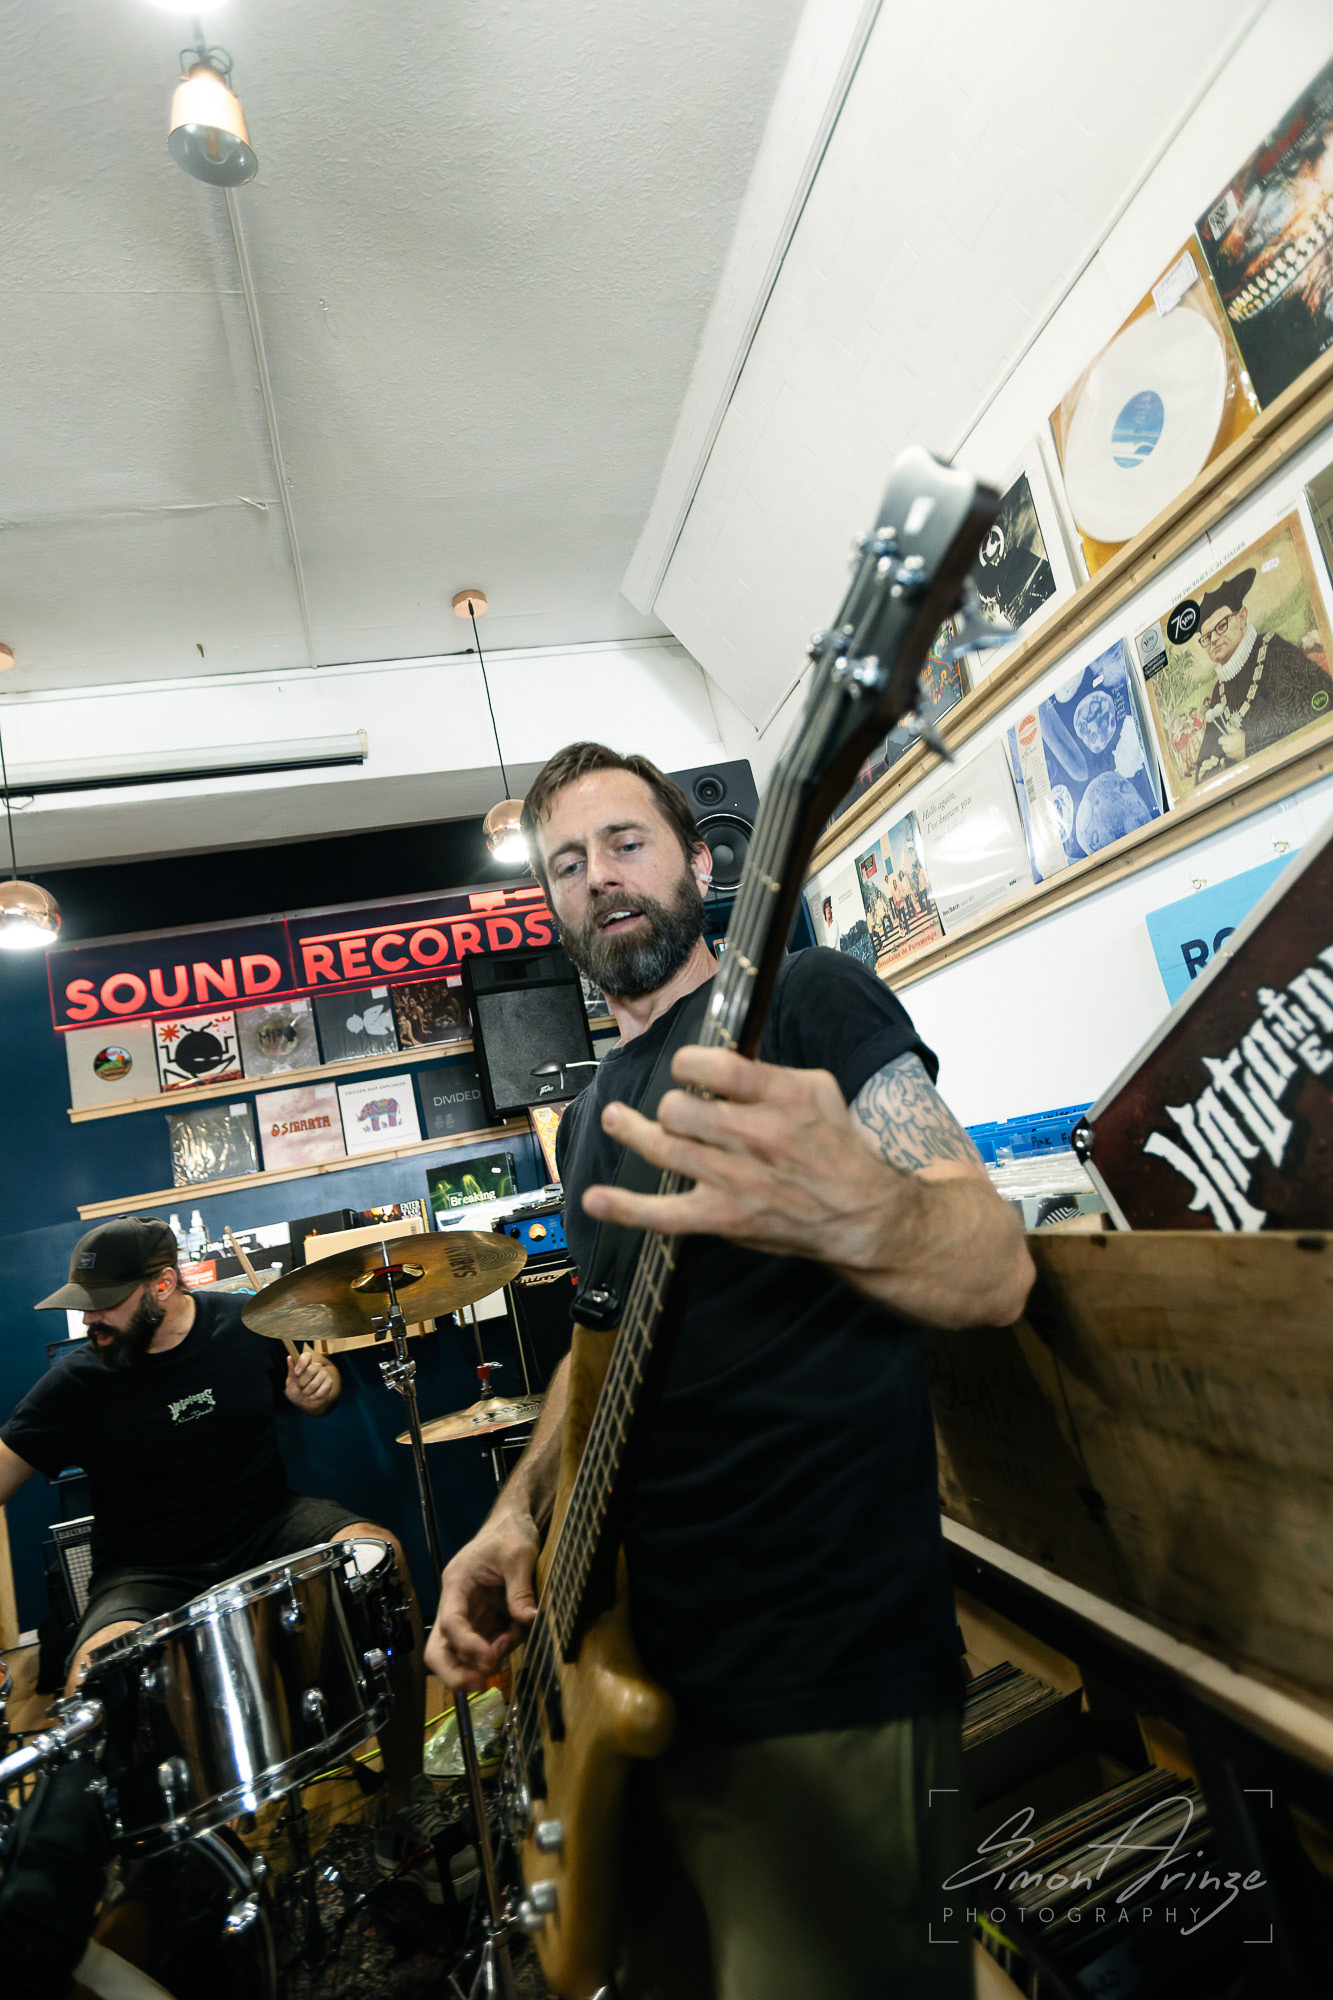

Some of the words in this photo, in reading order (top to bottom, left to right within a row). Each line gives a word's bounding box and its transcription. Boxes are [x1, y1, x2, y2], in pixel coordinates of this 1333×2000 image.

[922, 804, 938, 822] Hello
[960, 796, 973, 814] you
[65, 953, 282, 1021] SOUND
[301, 909, 553, 985] RECORDS
[433, 1089, 481, 1107] DIVIDED
[450, 1190, 497, 1207] Breaking
